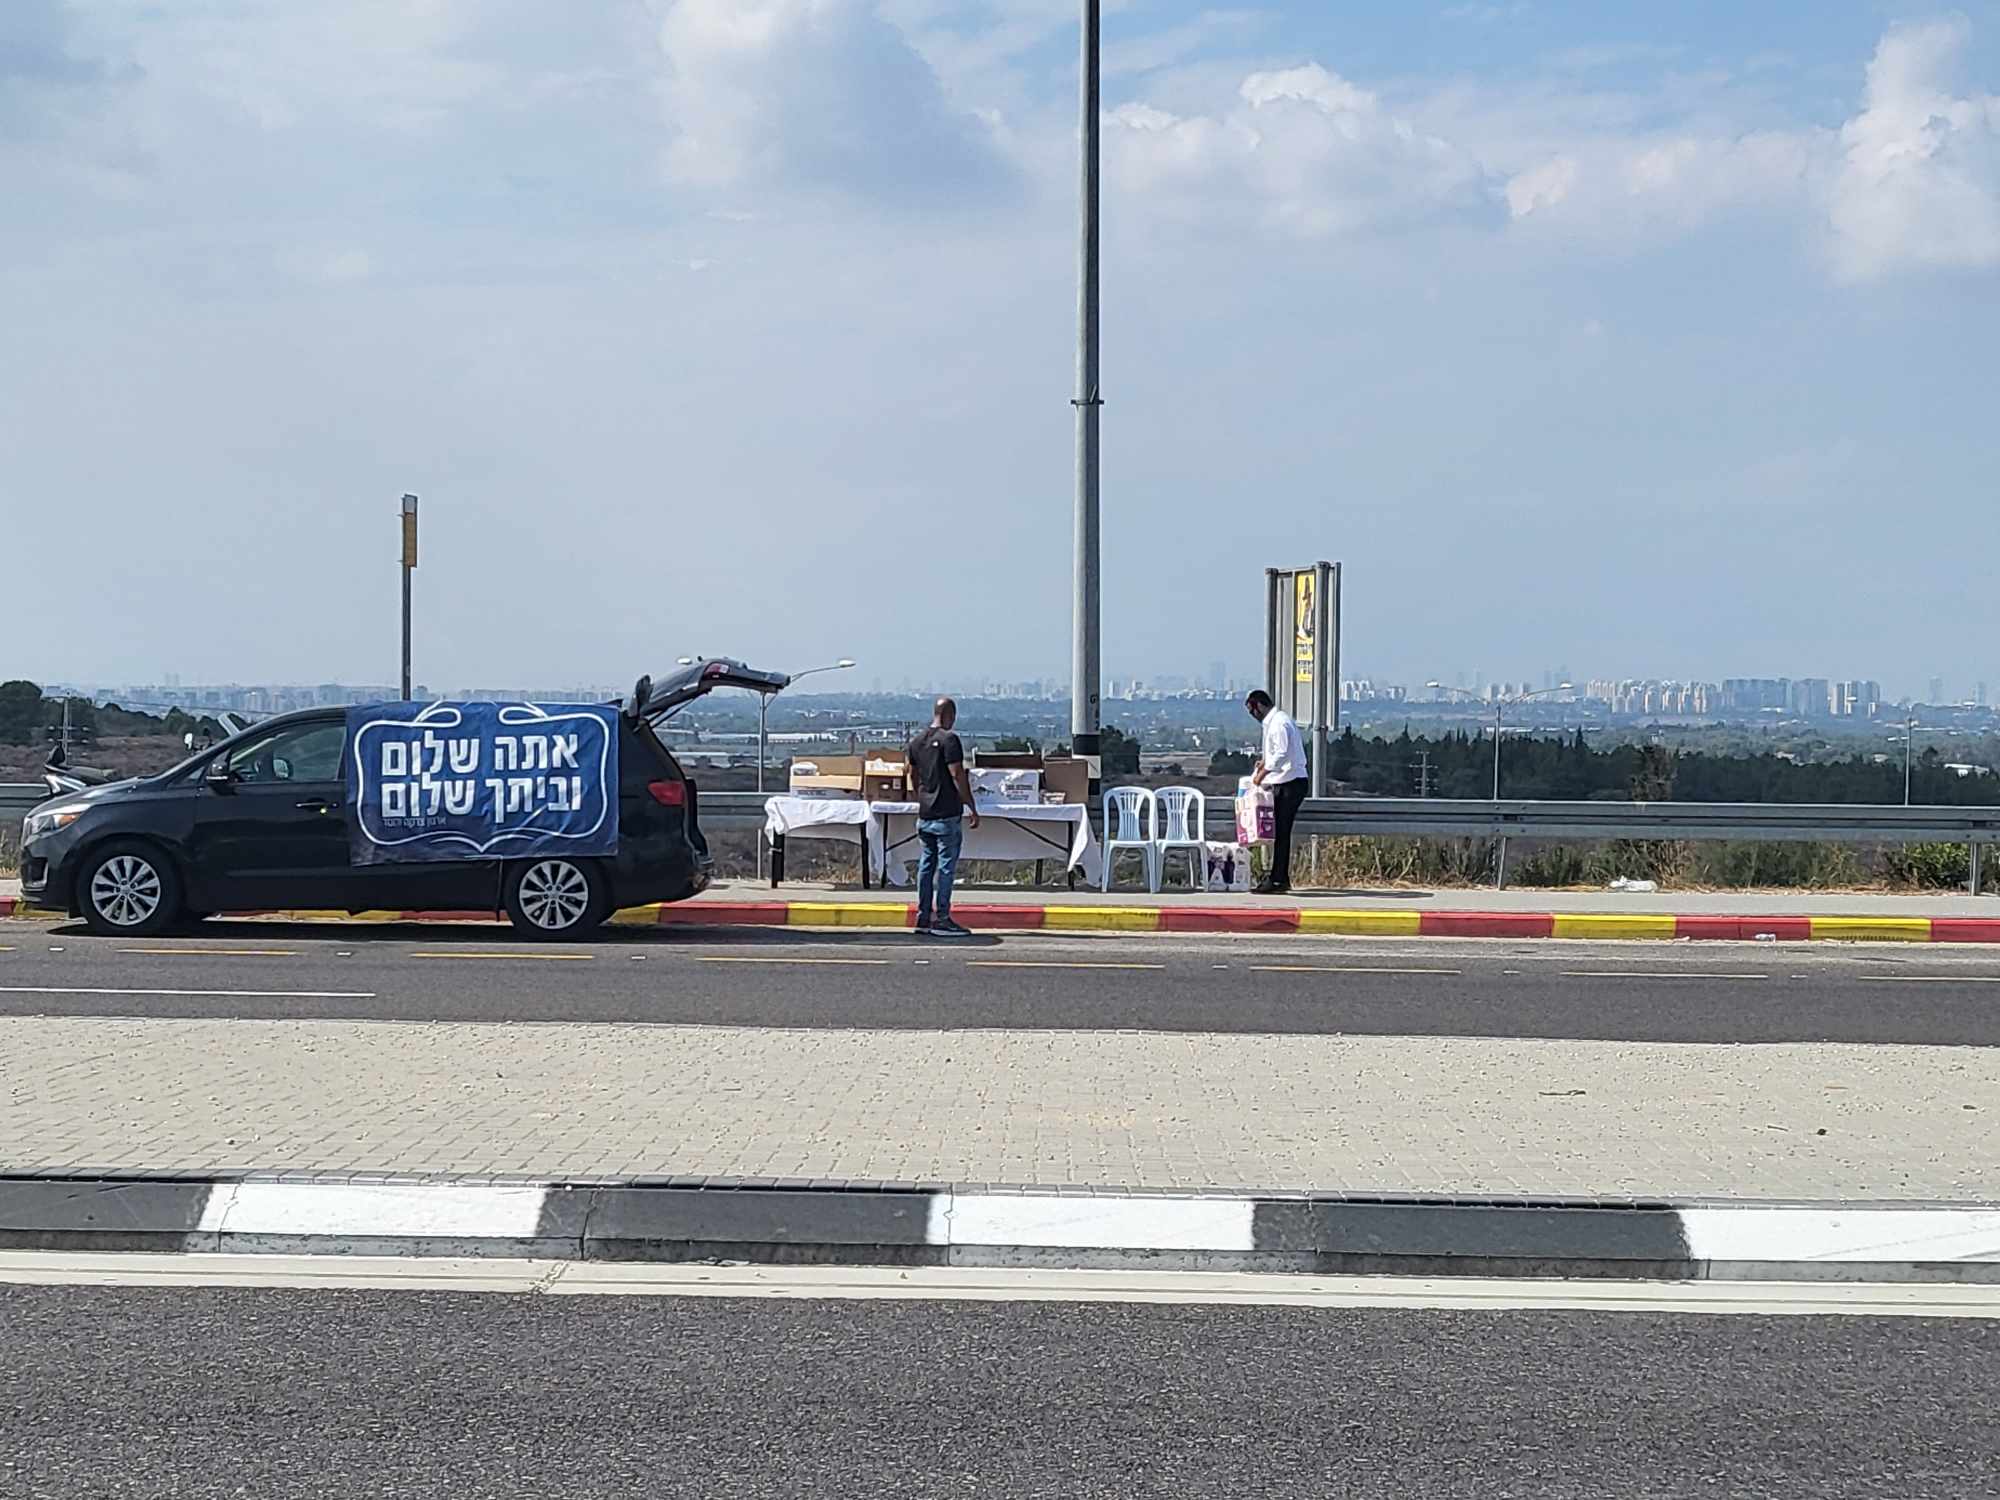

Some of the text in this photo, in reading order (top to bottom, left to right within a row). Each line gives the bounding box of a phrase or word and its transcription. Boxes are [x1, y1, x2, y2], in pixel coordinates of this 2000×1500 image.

[382, 730, 579, 776] אתה שלום
[381, 772, 581, 823] וביתך שלום
